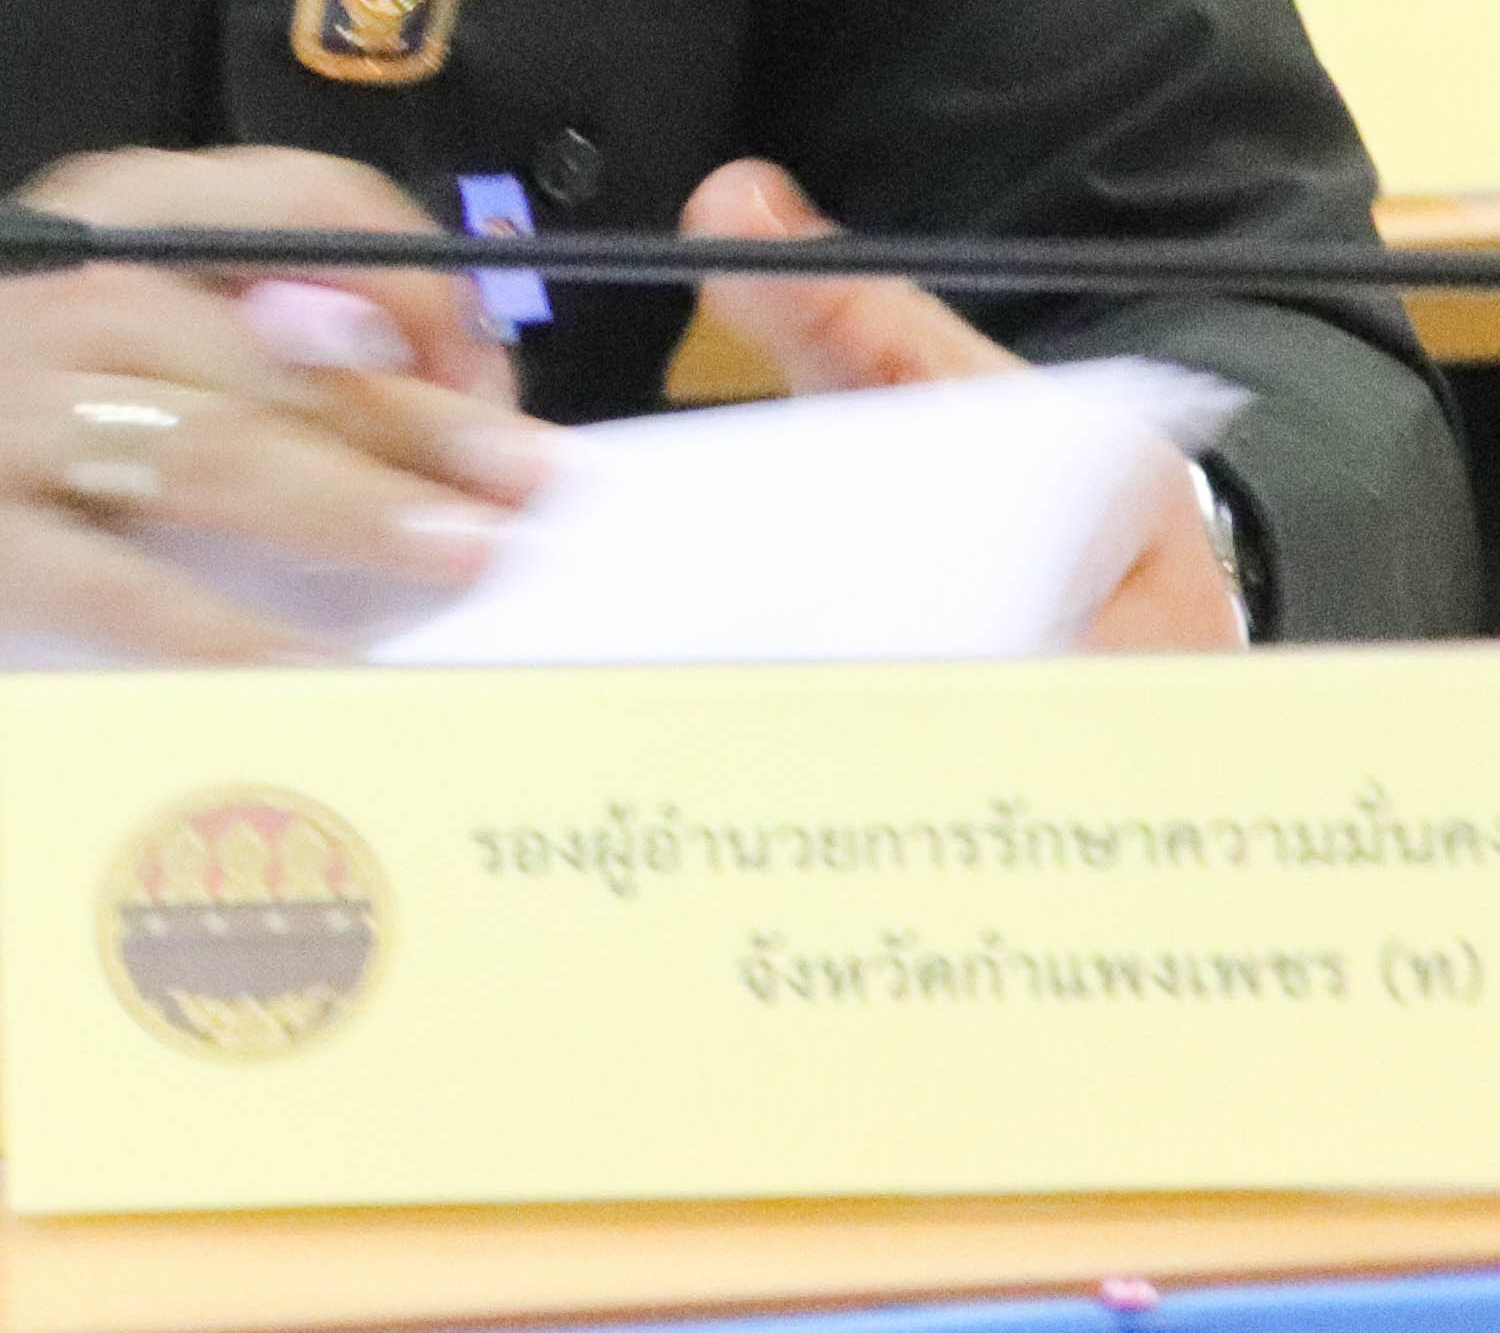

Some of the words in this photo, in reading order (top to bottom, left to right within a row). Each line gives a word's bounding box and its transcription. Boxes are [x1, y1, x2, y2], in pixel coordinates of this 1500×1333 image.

[738, 930, 1348, 1005] จังหวัดกำแพงเพชร
[1379, 938, 1485, 1004] (ท)
